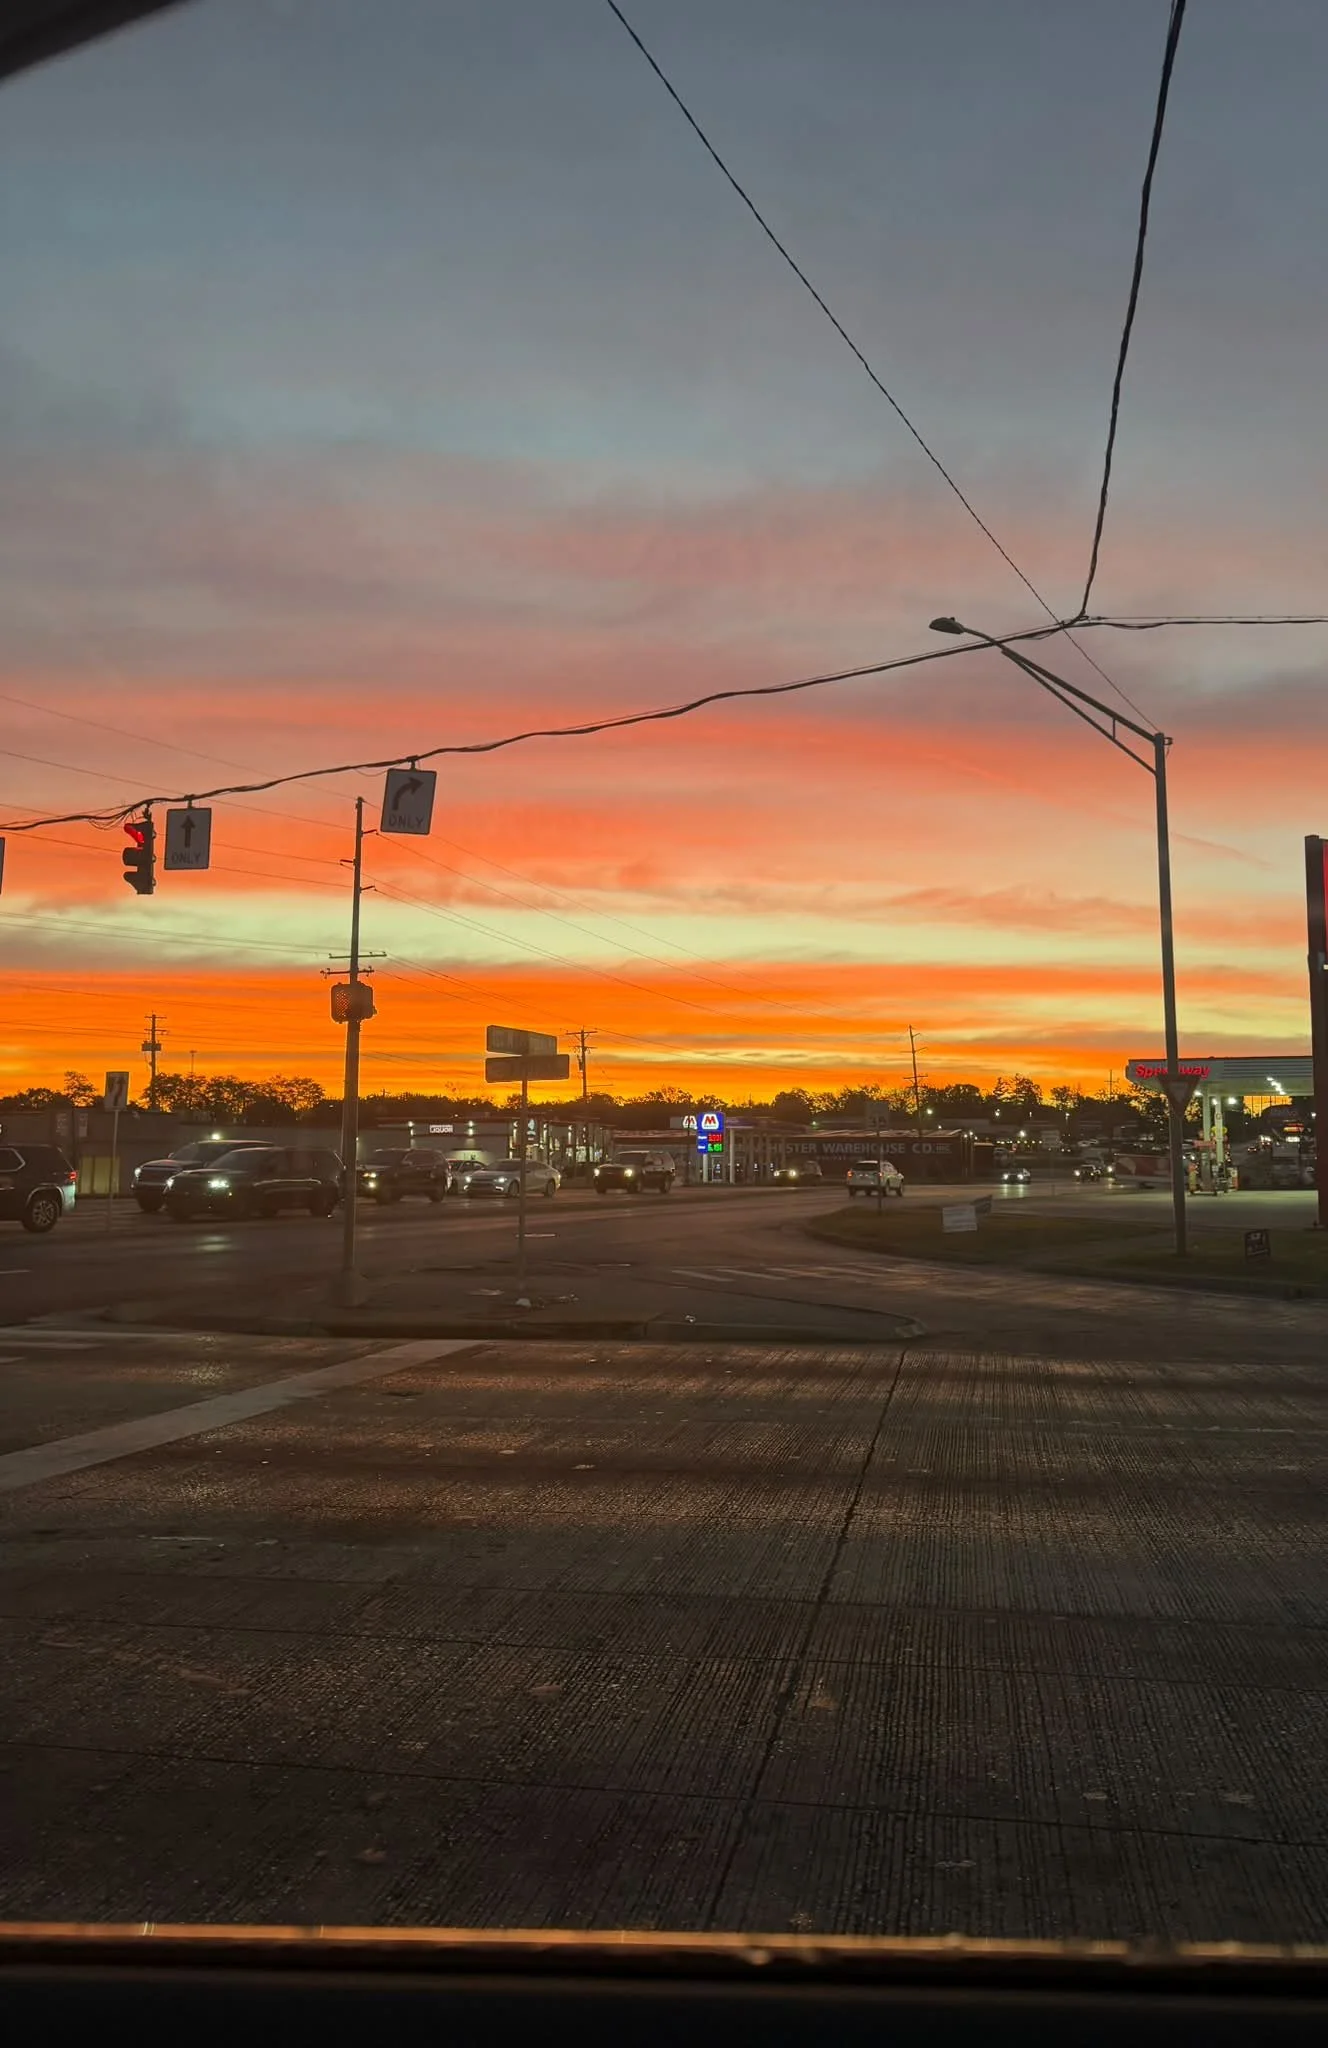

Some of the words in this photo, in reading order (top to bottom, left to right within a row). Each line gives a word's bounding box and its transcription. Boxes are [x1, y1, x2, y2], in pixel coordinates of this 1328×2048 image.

[388, 813, 424, 829] ONLY
[171, 851, 201, 864] ONLY
[822, 1142, 905, 1154] WAREHOUSE
